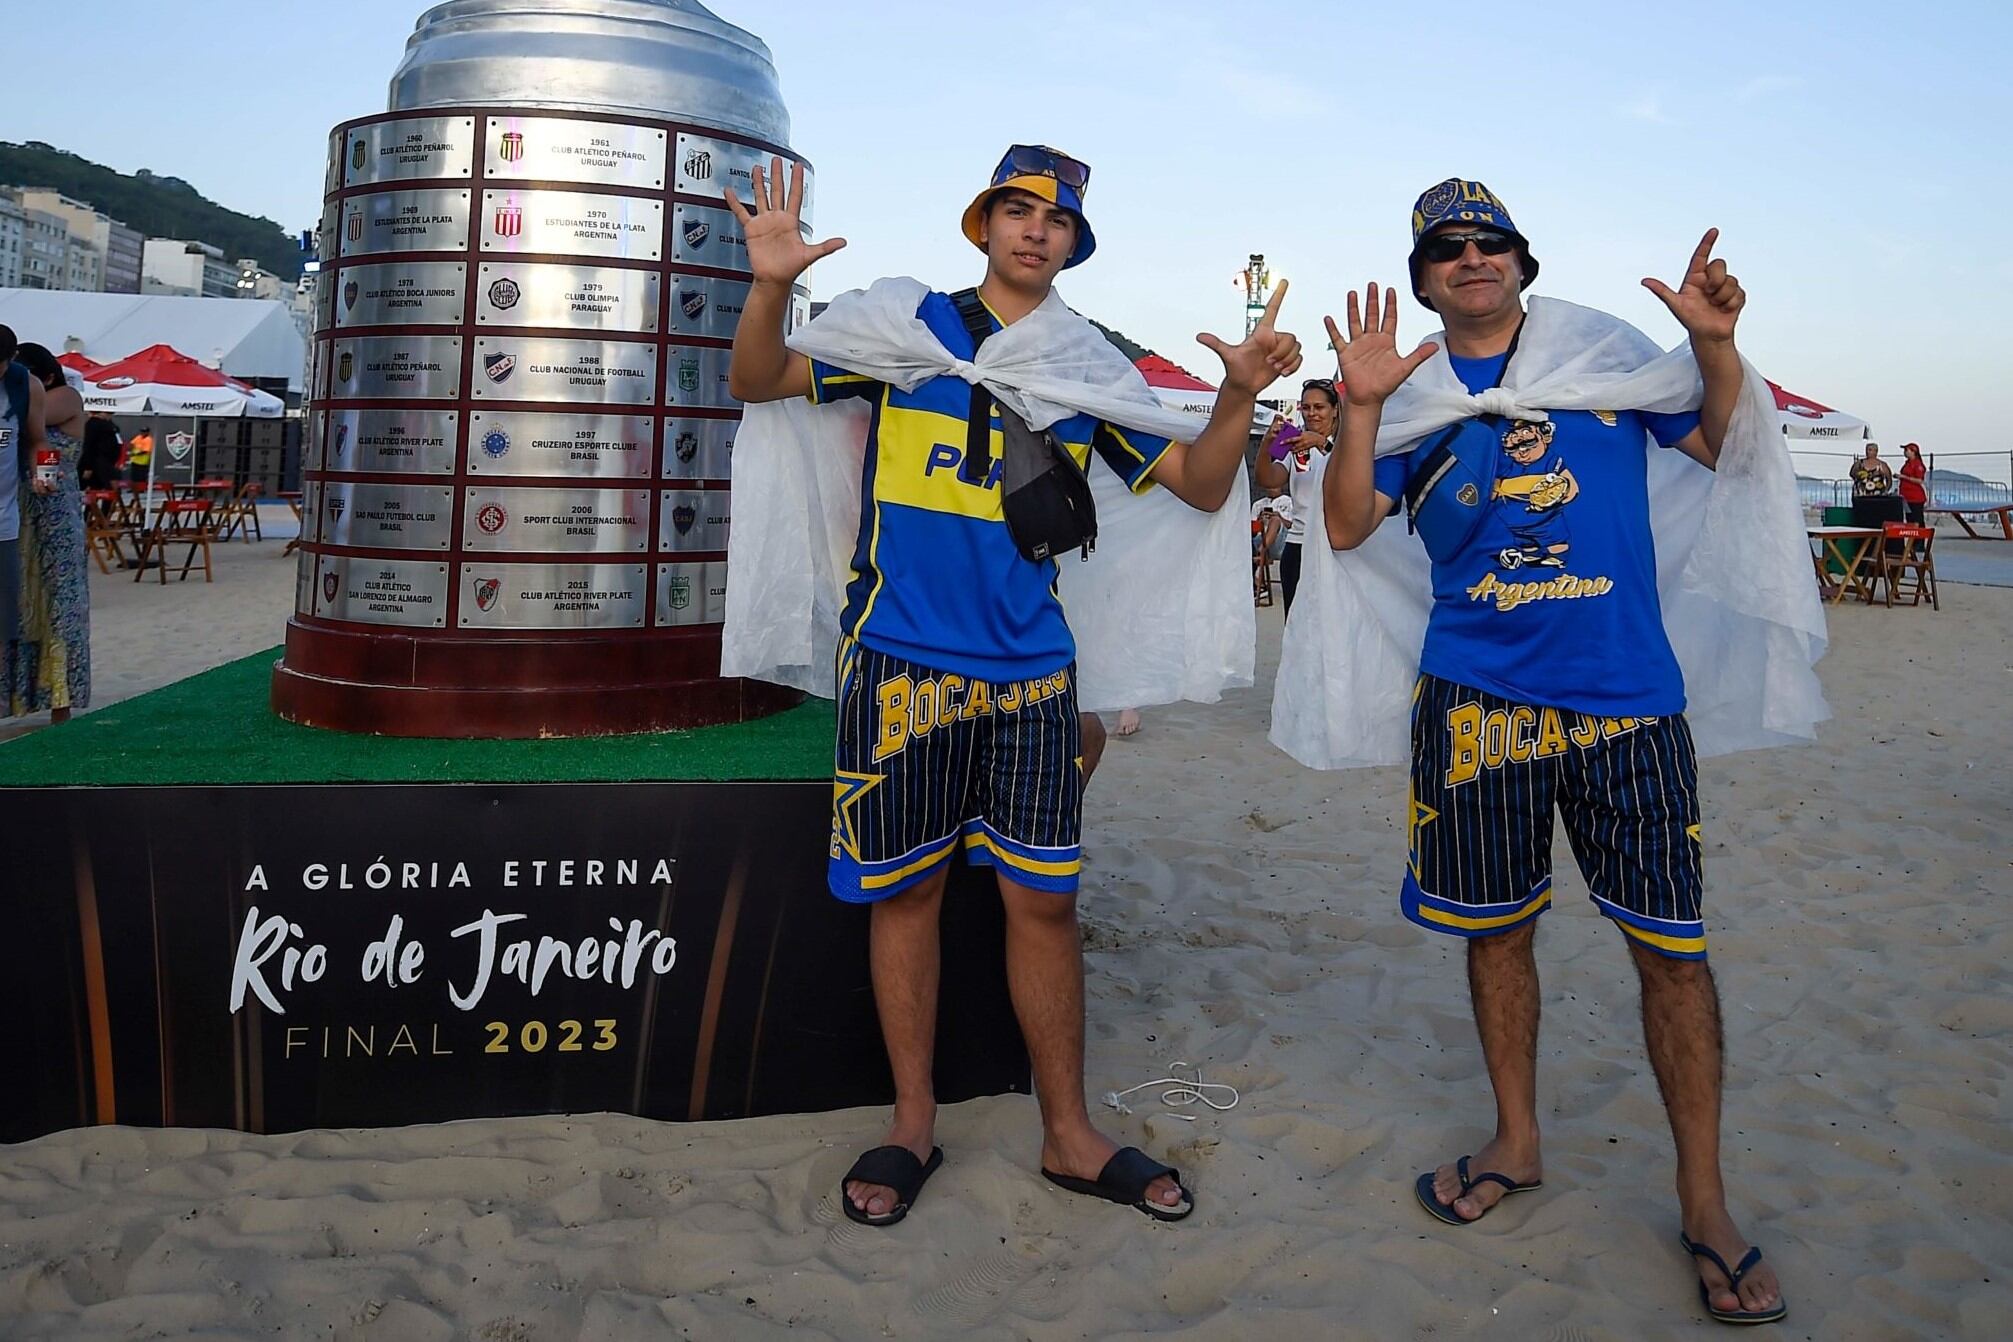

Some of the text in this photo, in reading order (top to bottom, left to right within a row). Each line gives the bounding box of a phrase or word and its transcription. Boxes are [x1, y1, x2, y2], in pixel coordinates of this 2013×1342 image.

[407, 134, 423, 142] 1960
[590, 138, 610, 147] 1961
[380, 146, 394, 155] CLUB
[423, 142, 454, 152] PEÑAROL
[551, 146, 572, 154] CLUB
[611, 149, 647, 161] PEÑAROL
[399, 155, 429, 163] URUGUAY
[580, 158, 618, 168] URUGUAY
[729, 168, 750, 179] SANTOS
[587, 210, 607, 219] 1970
[374, 216, 453, 226] ESTUDIANTES DE LA PLATA
[545, 218, 646, 233] ESTUDIANTES DE LA PLATA
[391, 226, 427, 235] ARGENTINA
[574, 230, 618, 240] ARGENTINA
[719, 235, 734, 244] CLUB
[583, 283, 603, 291] 1979
[406, 289, 425, 297] BOCA
[425, 289, 456, 297] JUNIORS
[564, 293, 620, 303] CLUB OLIMPIA
[388, 299, 423, 308] ARGENTINA
[571, 303, 612, 313] PARAGUAY
[579, 356, 600, 365] 1988
[366, 363, 381, 371] CLUB
[410, 361, 442, 371] PEÑAROL
[529, 365, 646, 378] CLUB NACIONAL DE FOOTBALL
[385, 374, 416, 382] URUGUAY
[569, 377, 607, 386] URUGUAY
[84, 397, 118, 407] AMSTEL
[180, 402, 216, 411] AMSTEL
[575, 431, 596, 439] 1997
[1809, 427, 1839, 437] AMSTEL
[400, 438, 421, 446] RIVER
[421, 438, 444, 447] PLATE
[531, 440, 638, 451] CRUZEIRO ESPORTE CLUBE
[379, 448, 414, 457] ARGENTINA
[570, 452, 600, 460] BRASIL
[571, 506, 593, 514] 2006
[367, 511, 385, 520] PAULO
[386, 512, 415, 521] FUTEBOL
[523, 516, 637, 525] SPORT CLUB INTERNACIONAL
[707, 517, 723, 525] CLUB
[379, 523, 403, 531] BRASIL
[566, 527, 596, 535] BRASIL
[379, 572, 396, 580] 2014
[365, 581, 381, 590] CLUB
[567, 581, 589, 589] 2015
[520, 590, 633, 600] CLUB ATLÉTICO RIVER PLATE
[1465, 572, 1615, 613] Argentina
[349, 591, 433, 604] SAN LORENZO DE ALMAGRO
[368, 603, 404, 613] ARGENTINA
[553, 602, 600, 611] ARGENTINA
[872, 672, 993, 765] BOCA
[1444, 700, 1569, 789] BOCA
[244, 864, 269, 891] A
[302, 855, 472, 890] GLÓRIA
[229, 905, 677, 1015] Rio de Janeiro
[285, 1019, 618, 1059] FINAL 2023
